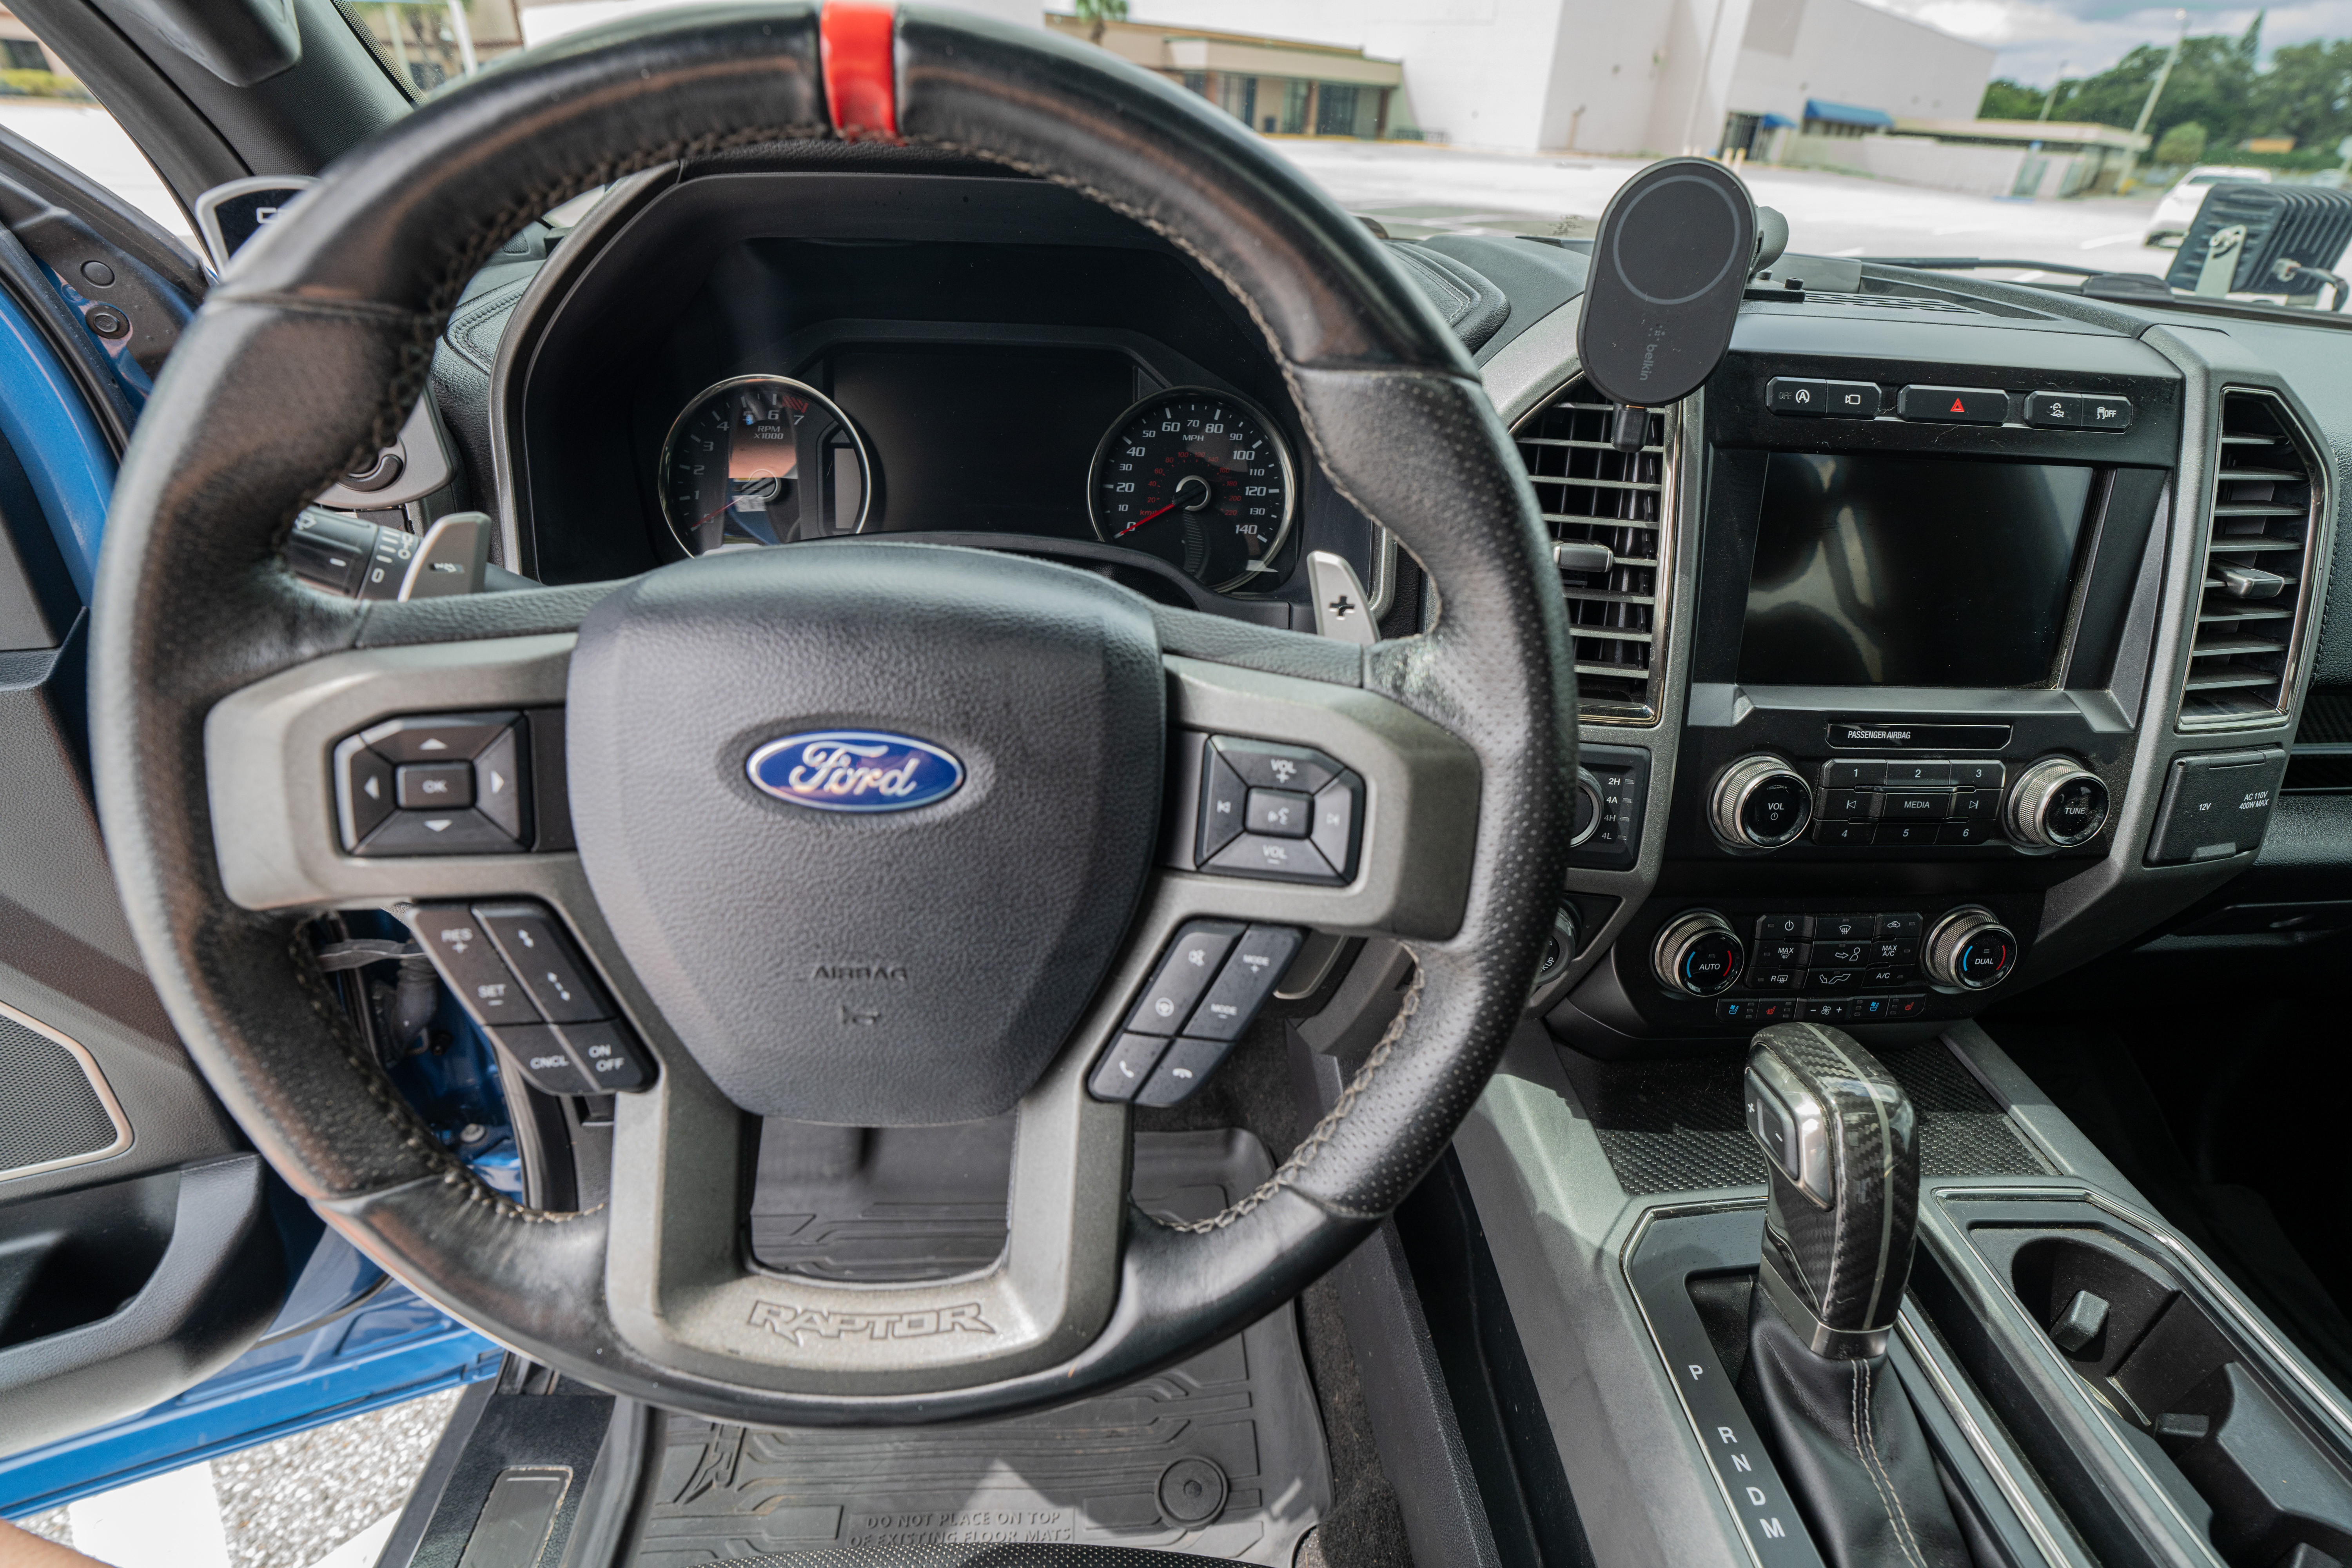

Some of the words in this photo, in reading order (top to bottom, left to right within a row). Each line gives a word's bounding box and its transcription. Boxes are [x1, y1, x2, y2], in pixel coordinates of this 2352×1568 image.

[1639, 343, 1658, 381] belkin
[768, 410, 779, 420] 6
[2104, 410, 2117, 418] OFF
[793, 415, 805, 425] 7
[1187, 419, 1200, 428] 70
[716, 421, 730, 431] 4
[1162, 422, 1181, 432] 60
[1205, 423, 1224, 434] 80
[1229, 433, 1243, 441] 90
[703, 441, 714, 451] 3
[1126, 447, 1145, 457] 40
[1232, 450, 1255, 461] 100
[693, 465, 705, 475] 2
[1249, 468, 1265, 477] 110
[1116, 483, 1135, 492] 20
[1245, 486, 1267, 496] 120
[694, 491, 699, 500] 1
[1127, 522, 1136, 531] 0
[1235, 525, 1258, 535] 140
[1848, 730, 1886, 739] PASSENGER
[1886, 731, 1911, 739] AIRBAG
[789, 740, 920, 796] Ford
[1270, 759, 1297, 774] VOL
[1854, 768, 1858, 777] 1
[1915, 769, 1921, 778] 2
[1976, 769, 1982, 778] 3
[2254, 791, 2268, 800] 110V
[2199, 803, 2211, 811] 12V
[2239, 801, 2255, 810] 400W
[2255, 799, 2269, 808] MAX
[1841, 829, 1847, 838] 4
[1902, 829, 1909, 837] 5
[1963, 829, 1969, 837] 6
[1263, 844, 1287, 860] VOL
[441, 928, 473, 942] RES
[1243, 955, 1270, 967] MODE
[478, 984, 506, 998] SET
[1210, 1004, 1238, 1016] MODE
[588, 1045, 612, 1058] ON
[530, 1055, 570, 1069] CNCL
[596, 1058, 624, 1072] OFF
[747, 1300, 996, 1347] RAPTOR
[1688, 1364, 1703, 1380] P
[1717, 1426, 1738, 1444] R
[1731, 1454, 1752, 1472] N
[1746, 1486, 1766, 1506] D
[867, 1515, 892, 1529] DO
[898, 1513, 933, 1528] NOT
[940, 1511, 991, 1526] PLACE
[998, 1512, 1022, 1525] ON
[1027, 1512, 1060, 1525] TOP
[1759, 1517, 1786, 1538] M
[851, 1534, 873, 1547] OF
[877, 1531, 957, 1546] EXISTING
[964, 1530, 1018, 1543] FLOOR
[1025, 1528, 1071, 1542] MATS
